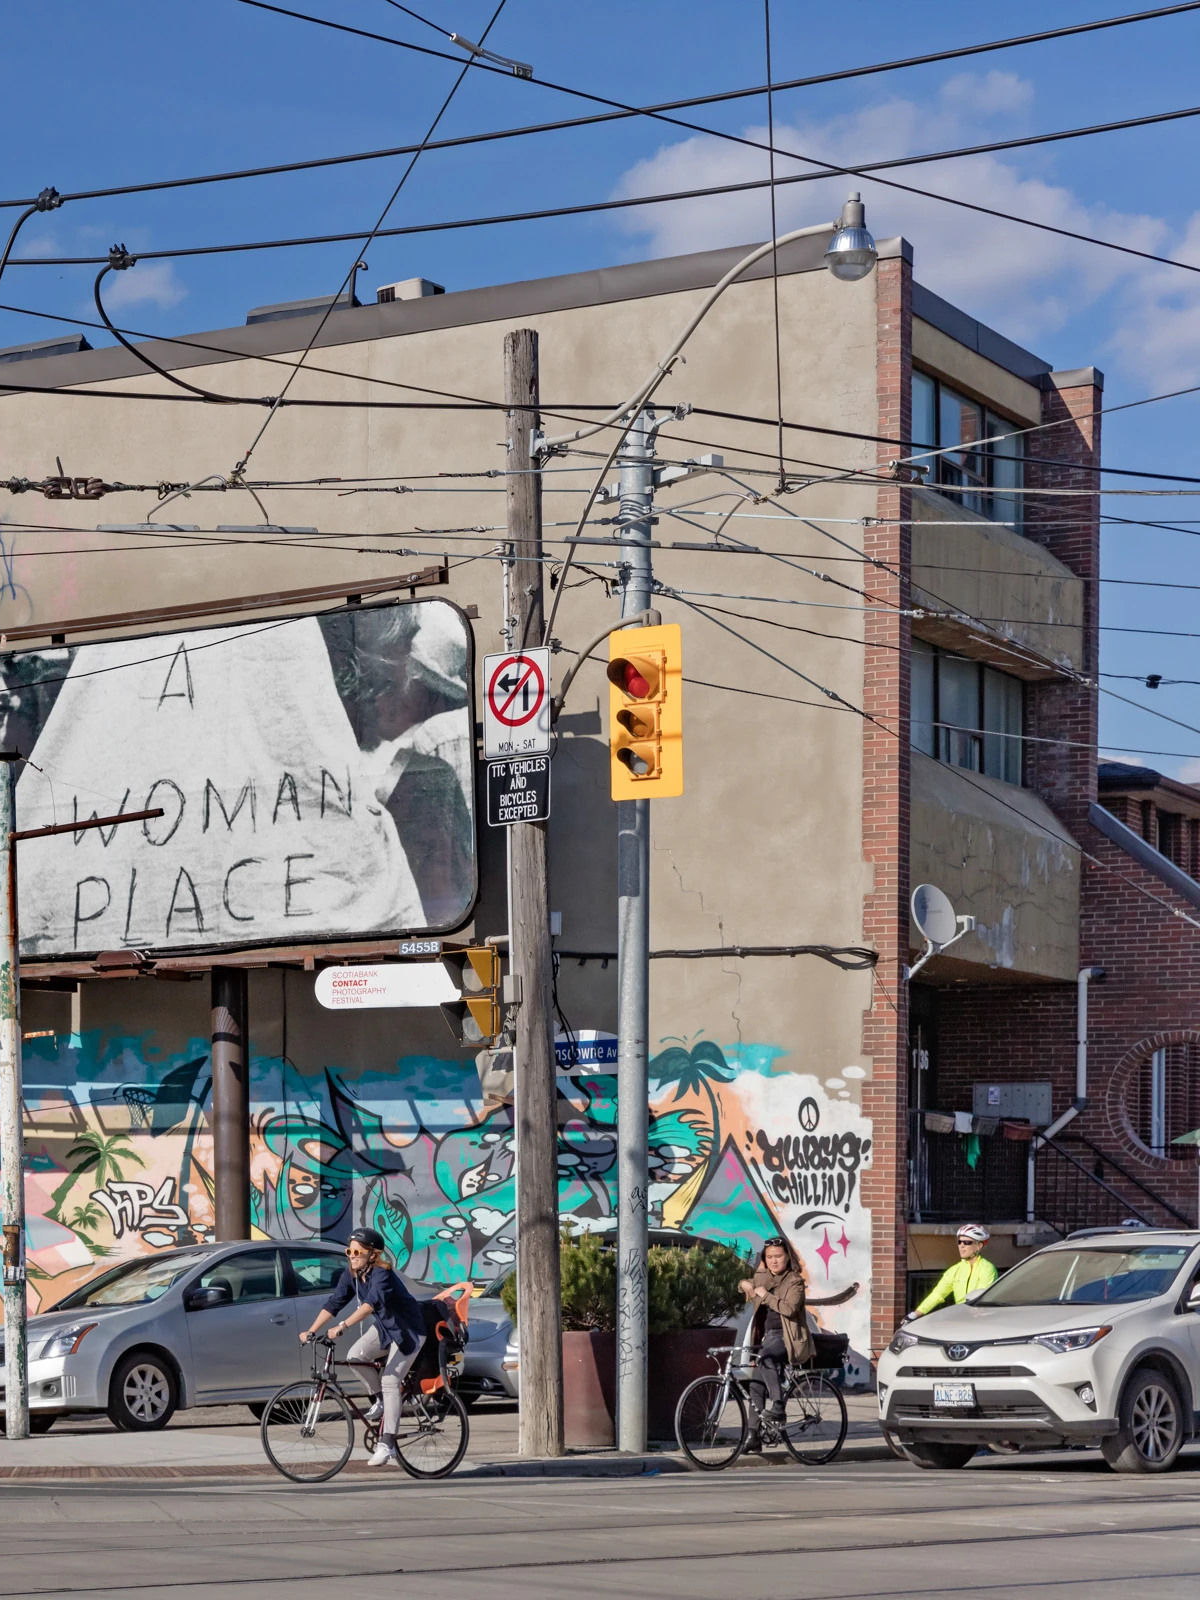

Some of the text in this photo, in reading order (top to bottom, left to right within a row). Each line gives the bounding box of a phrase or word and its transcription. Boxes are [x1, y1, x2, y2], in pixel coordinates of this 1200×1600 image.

[157, 640, 195, 712] A
[498, 741, 514, 753] MON
[523, 738, 536, 750] SAT
[491, 758, 546, 778] TTC VEHICLES
[510, 776, 527, 790] AND
[500, 790, 537, 807] BICYCLES
[499, 804, 538, 821] EXCEPTED
[73, 853, 319, 951] PLACE
[401, 941, 439, 954] 5455B
[332, 970, 378, 979] SCOTIABANK
[332, 979, 368, 988] CONTACT
[332, 987, 387, 996] PHOTOGRAPHY
[332, 997, 364, 1005] FESTIVAL
